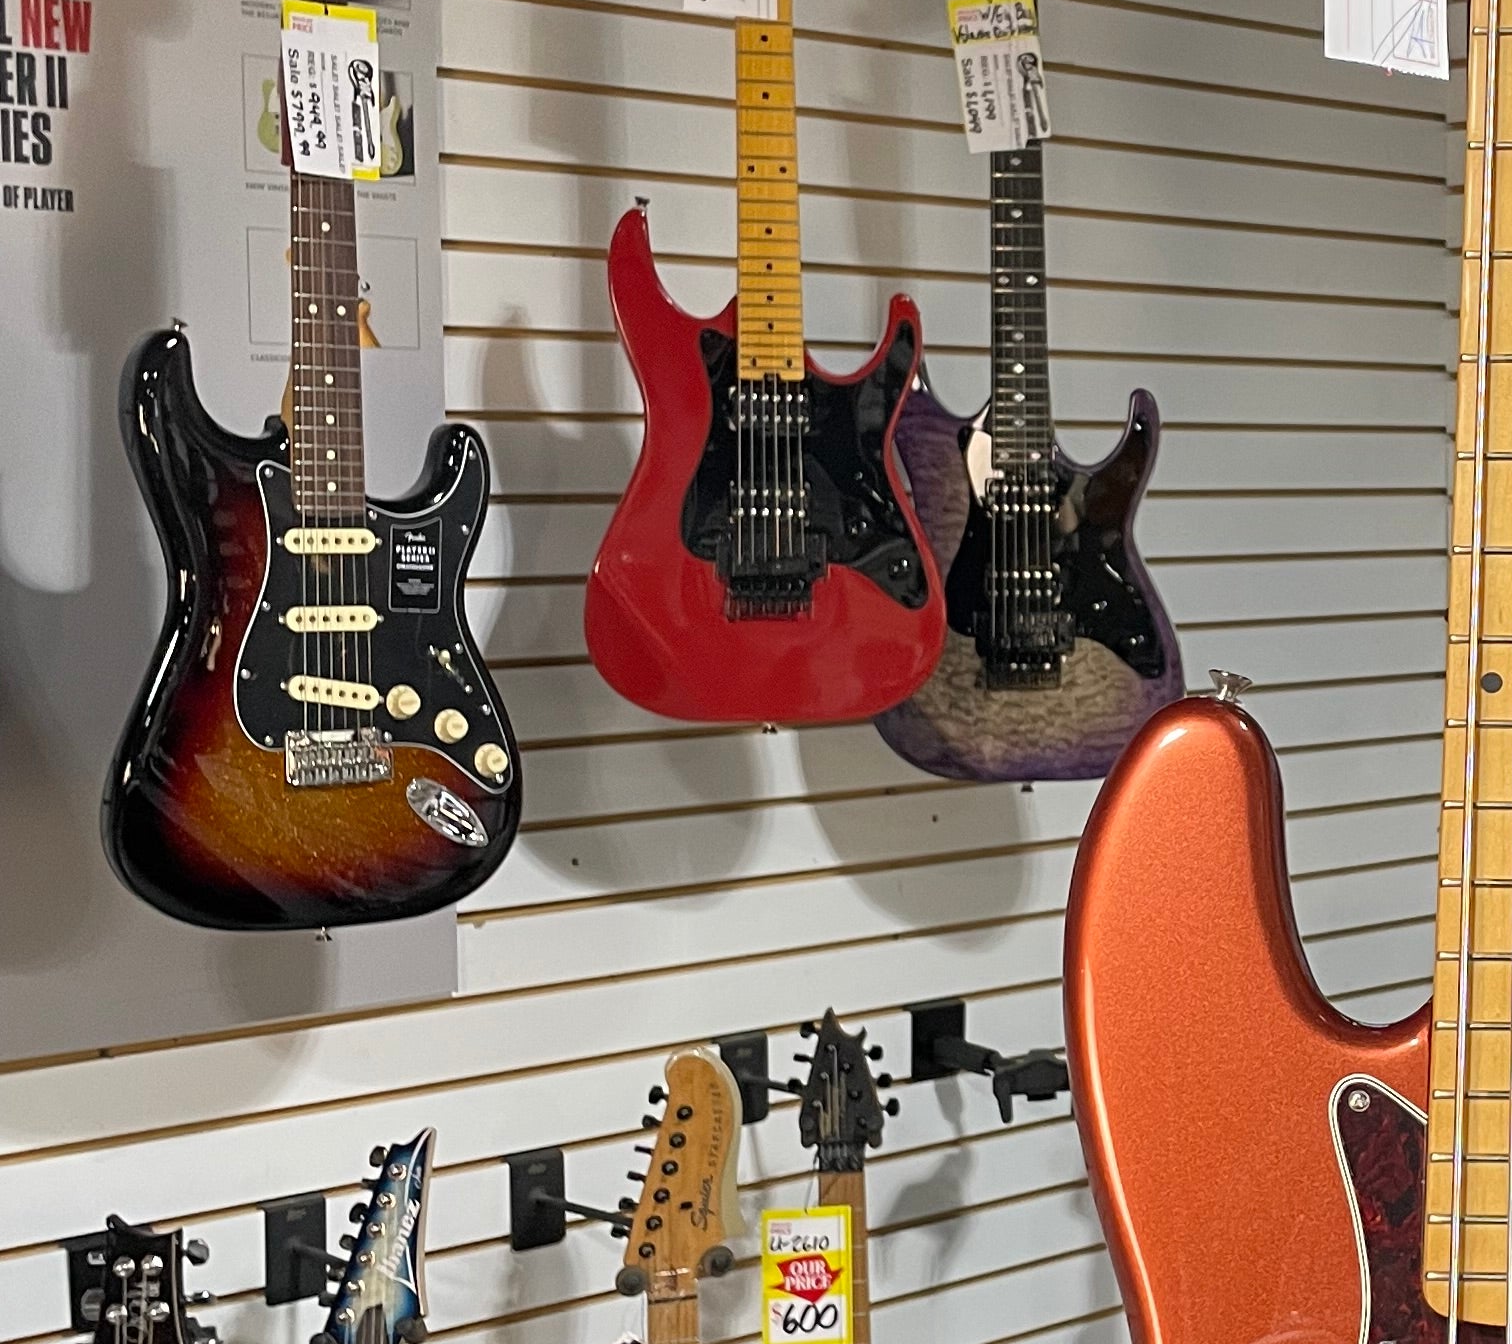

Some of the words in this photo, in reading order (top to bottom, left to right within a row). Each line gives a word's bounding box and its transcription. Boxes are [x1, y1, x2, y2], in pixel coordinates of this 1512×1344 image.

[288, 48, 302, 84] Sale
[3, 184, 19, 208] OF
[24, 187, 74, 212] PLAYER
[690, 1173, 715, 1234] Squier
[375, 1197, 422, 1280] Ibanez
[784, 1273, 833, 1292] PRICE
[789, 1259, 827, 1277] OUR
